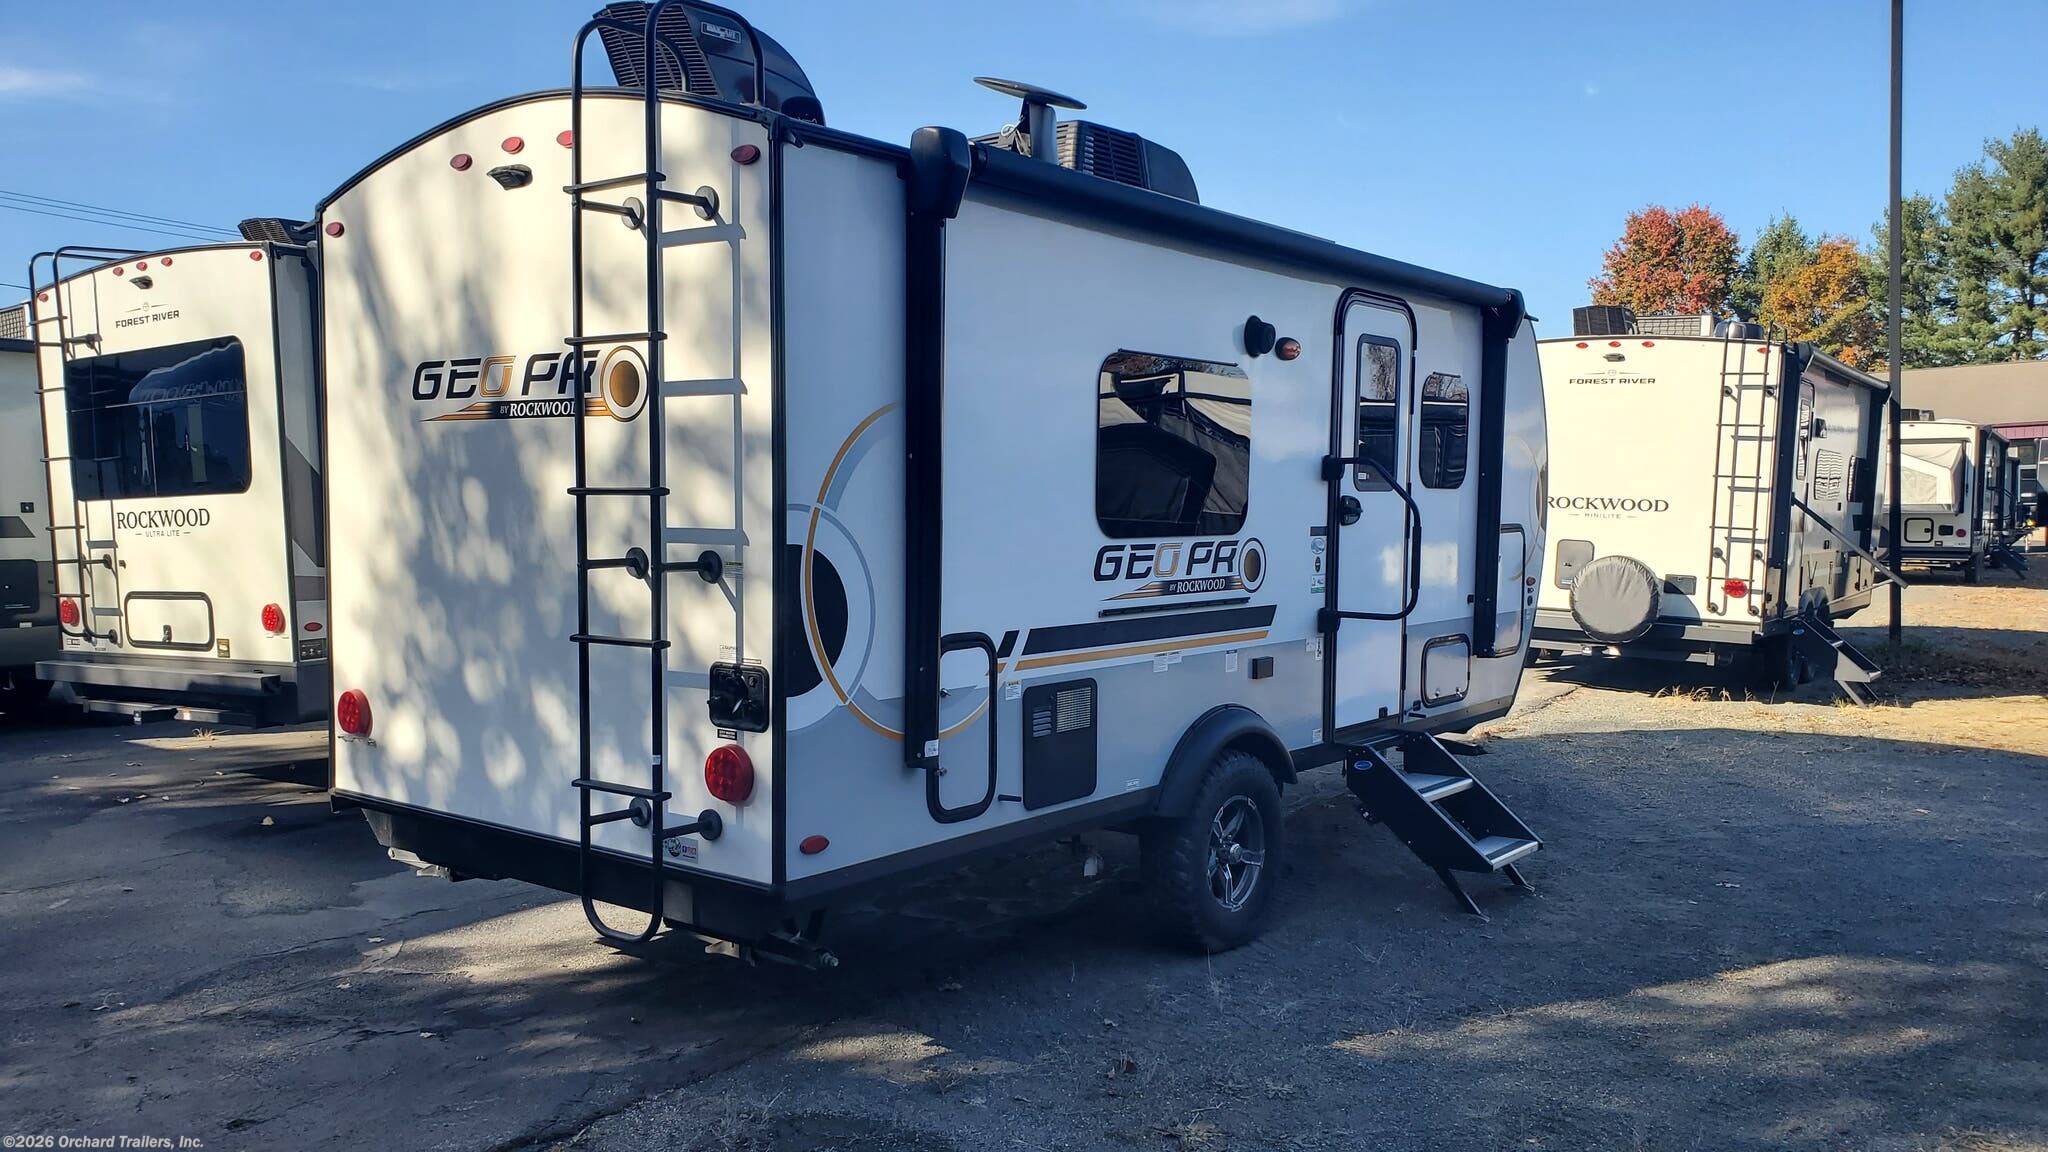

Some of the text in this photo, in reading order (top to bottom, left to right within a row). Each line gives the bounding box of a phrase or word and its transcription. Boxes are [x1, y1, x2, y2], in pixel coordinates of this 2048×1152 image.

[115, 309, 180, 328] FOREST RIVER
[412, 355, 516, 401] GEO
[500, 405, 509, 414] BY
[116, 508, 210, 529] ROCKWOOD
[145, 529, 180, 538] ULTRA LITE
[1093, 537, 1267, 593] GEO PRO
[1169, 578, 1226, 593] BY ROCKWOOD
